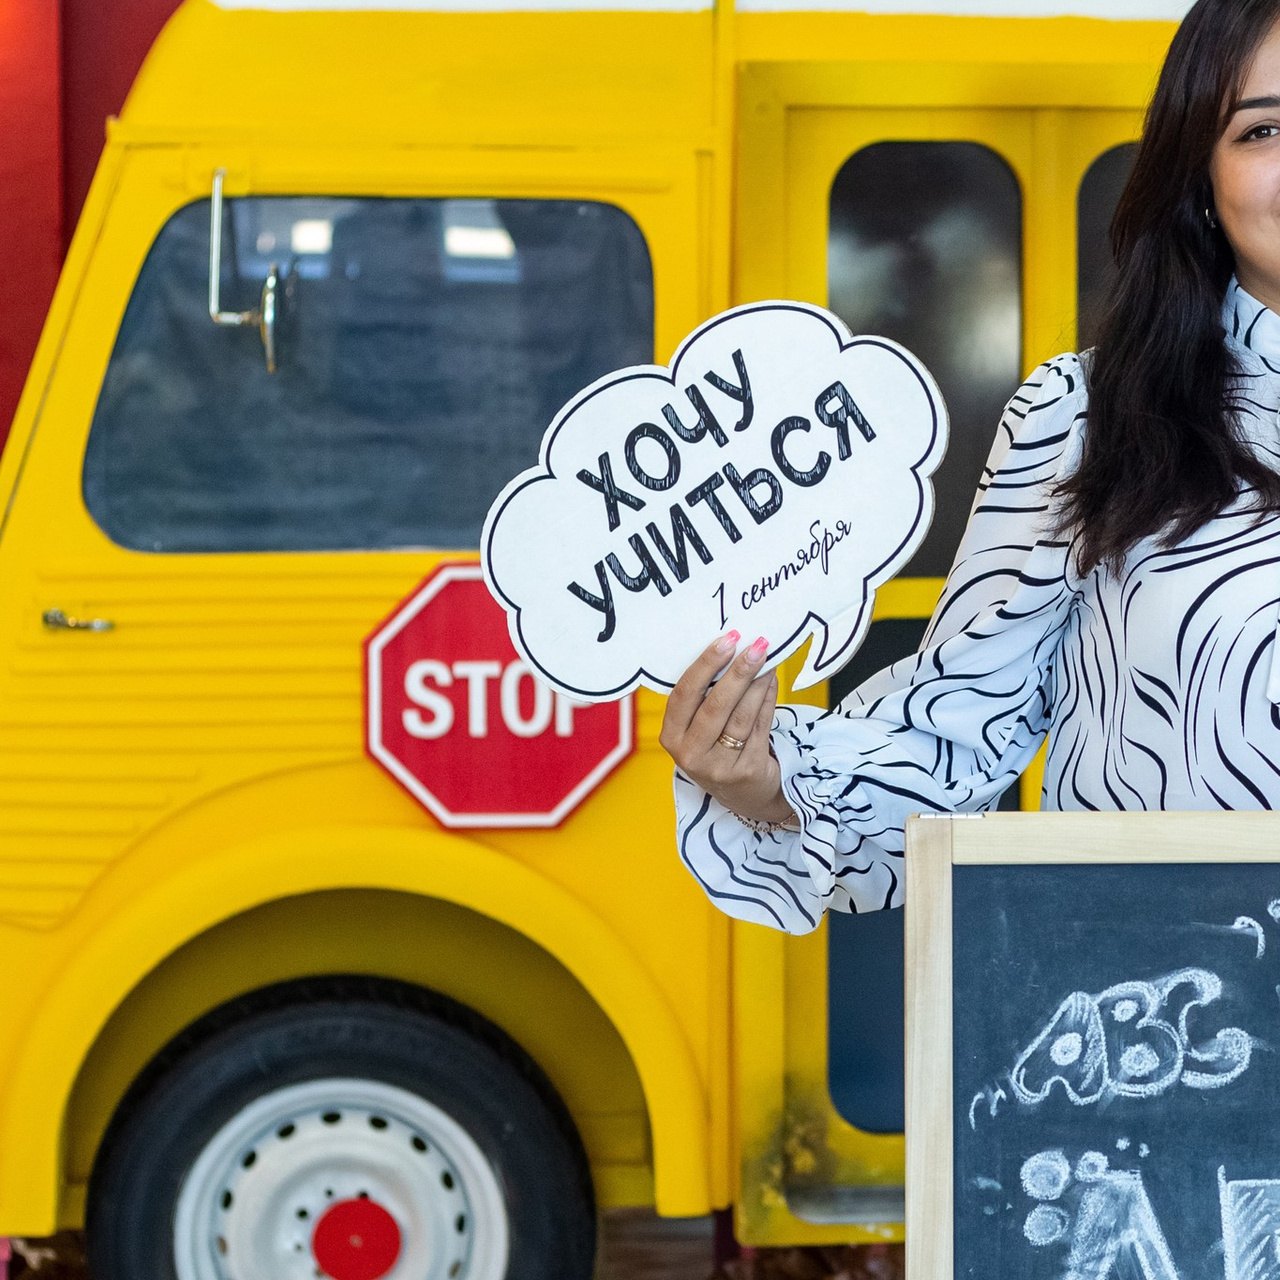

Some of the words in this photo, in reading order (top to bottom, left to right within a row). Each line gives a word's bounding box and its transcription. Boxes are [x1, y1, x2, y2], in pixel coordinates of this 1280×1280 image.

[567, 381, 876, 642] УЧИТЬСЯ
[576, 348, 754, 532] ХОЧУ
[712, 582, 728, 630] 1
[741, 520, 852, 610] сентября
